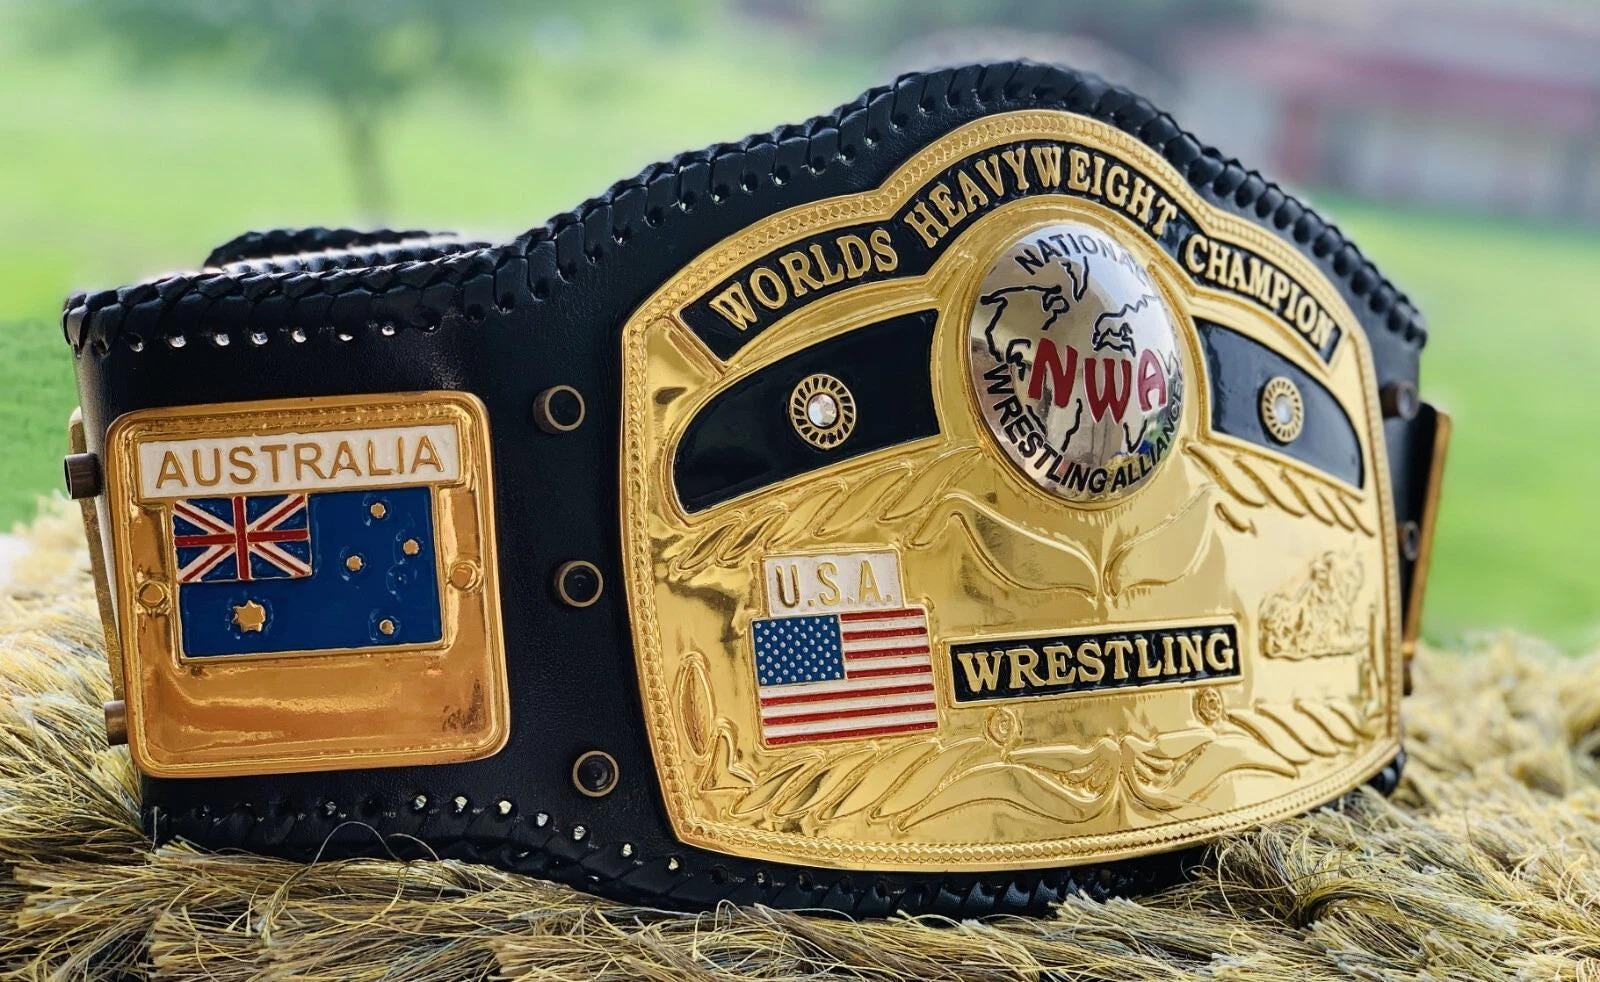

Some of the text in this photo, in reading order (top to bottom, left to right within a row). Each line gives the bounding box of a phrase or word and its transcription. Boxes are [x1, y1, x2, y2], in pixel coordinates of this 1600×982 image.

[708, 146, 1337, 349] WORLDS HEAVYWEIGHT CHAMPION
[1028, 337, 1167, 424] NWA
[155, 434, 445, 489] AUSTRALIA
[983, 363, 1106, 494] WRESTLING
[775, 560, 895, 608] U.S.A.
[956, 631, 1235, 694] WRESTLING
